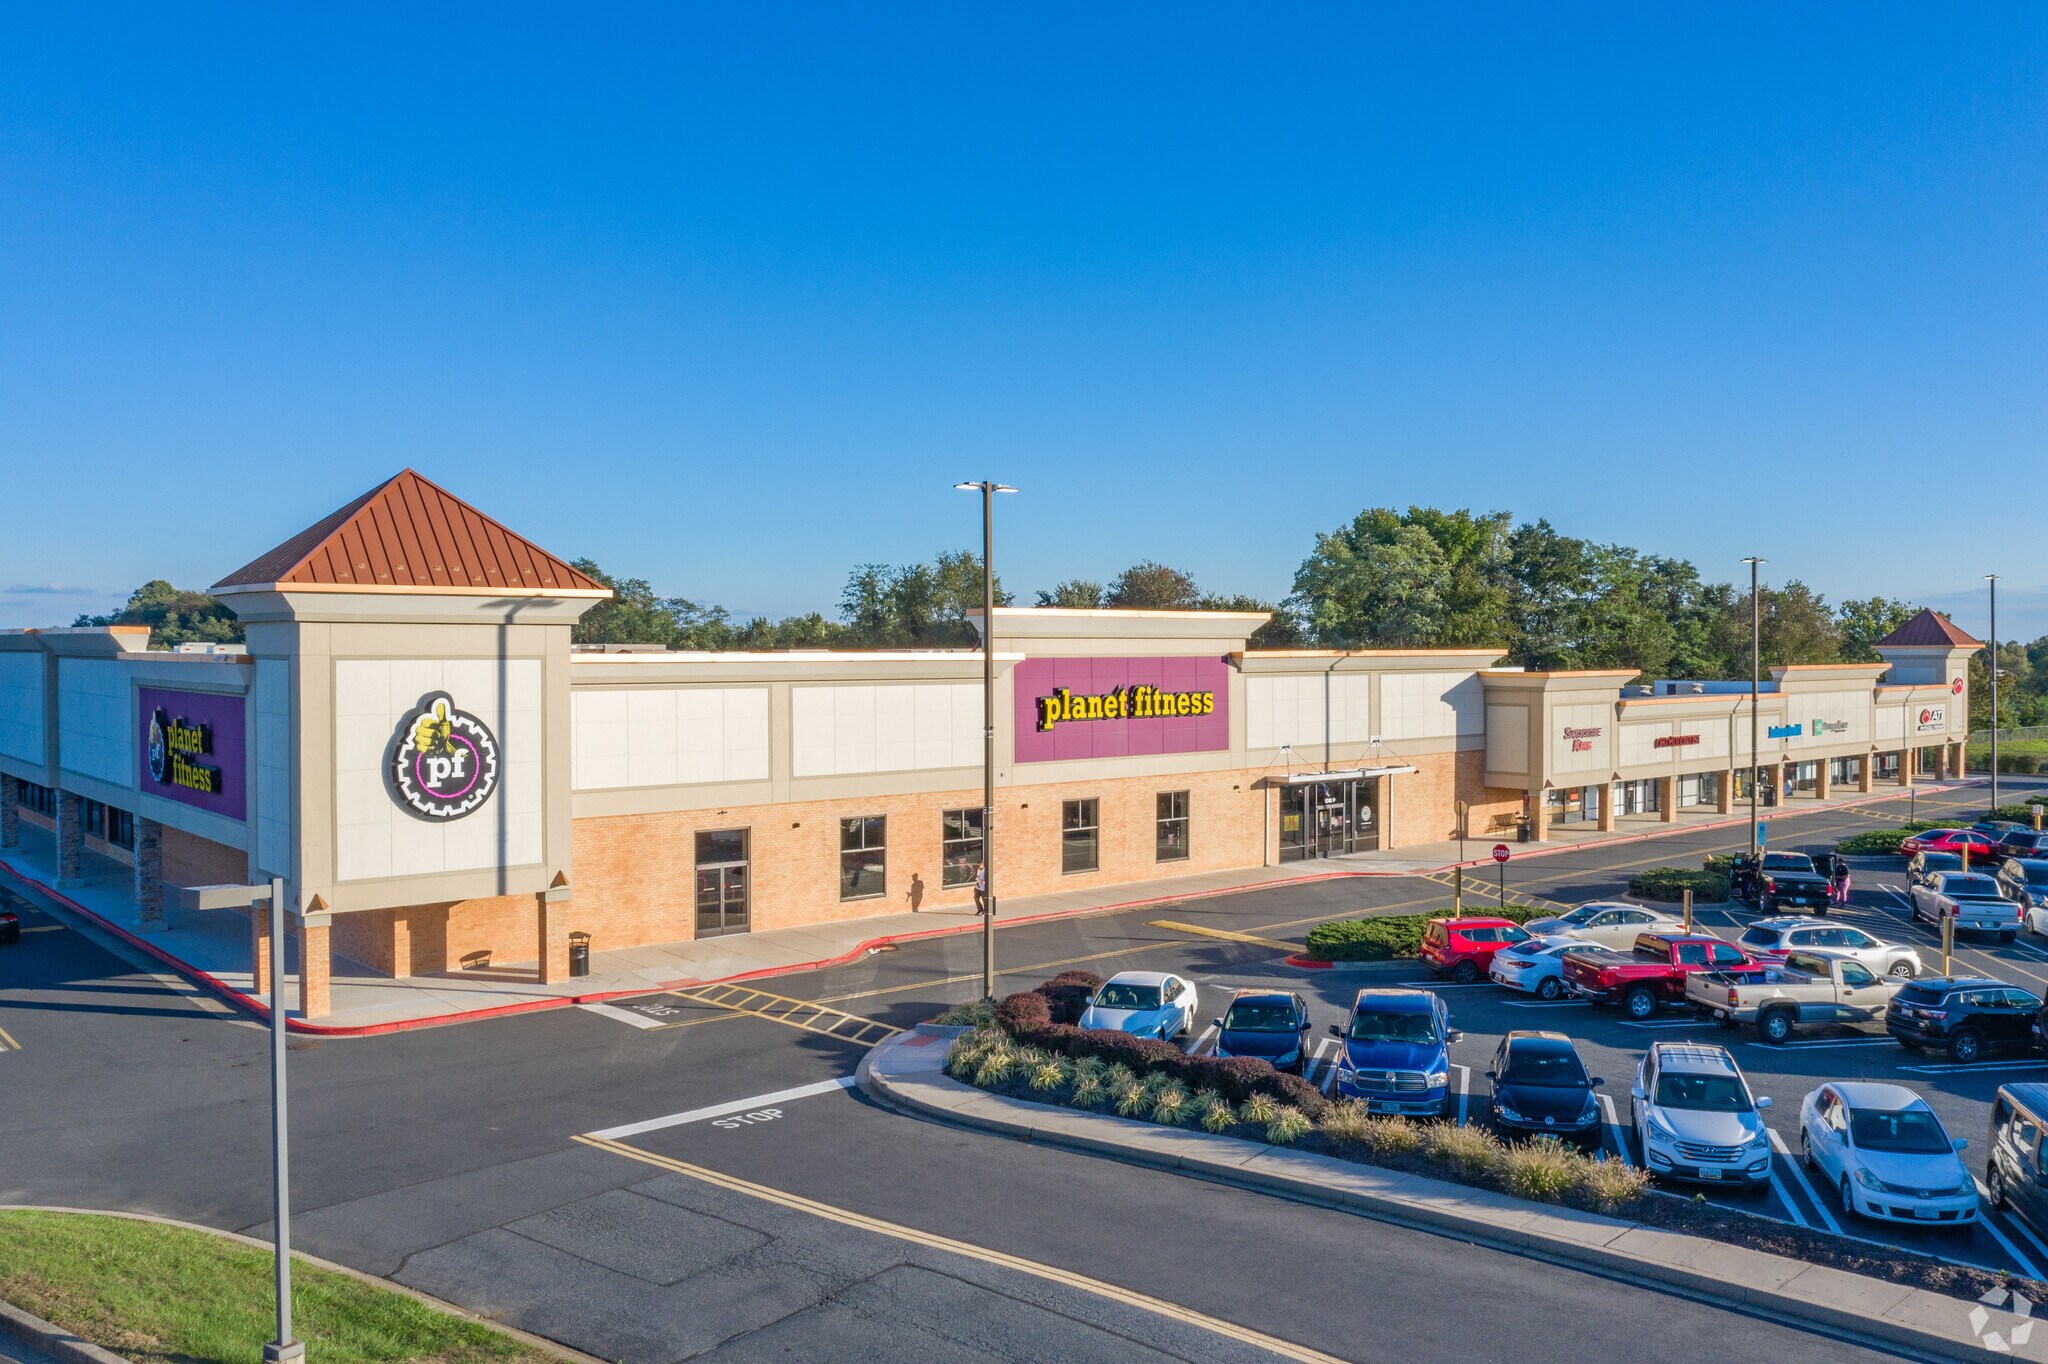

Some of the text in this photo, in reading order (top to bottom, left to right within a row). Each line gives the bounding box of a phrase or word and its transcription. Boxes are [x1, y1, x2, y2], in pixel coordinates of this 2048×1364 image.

[1044, 686, 1214, 730] planet fitness
[167, 717, 204, 756] planet
[173, 754, 212, 793] fitness
[427, 748, 469, 787] pf
[712, 1108, 782, 1129] STOP
